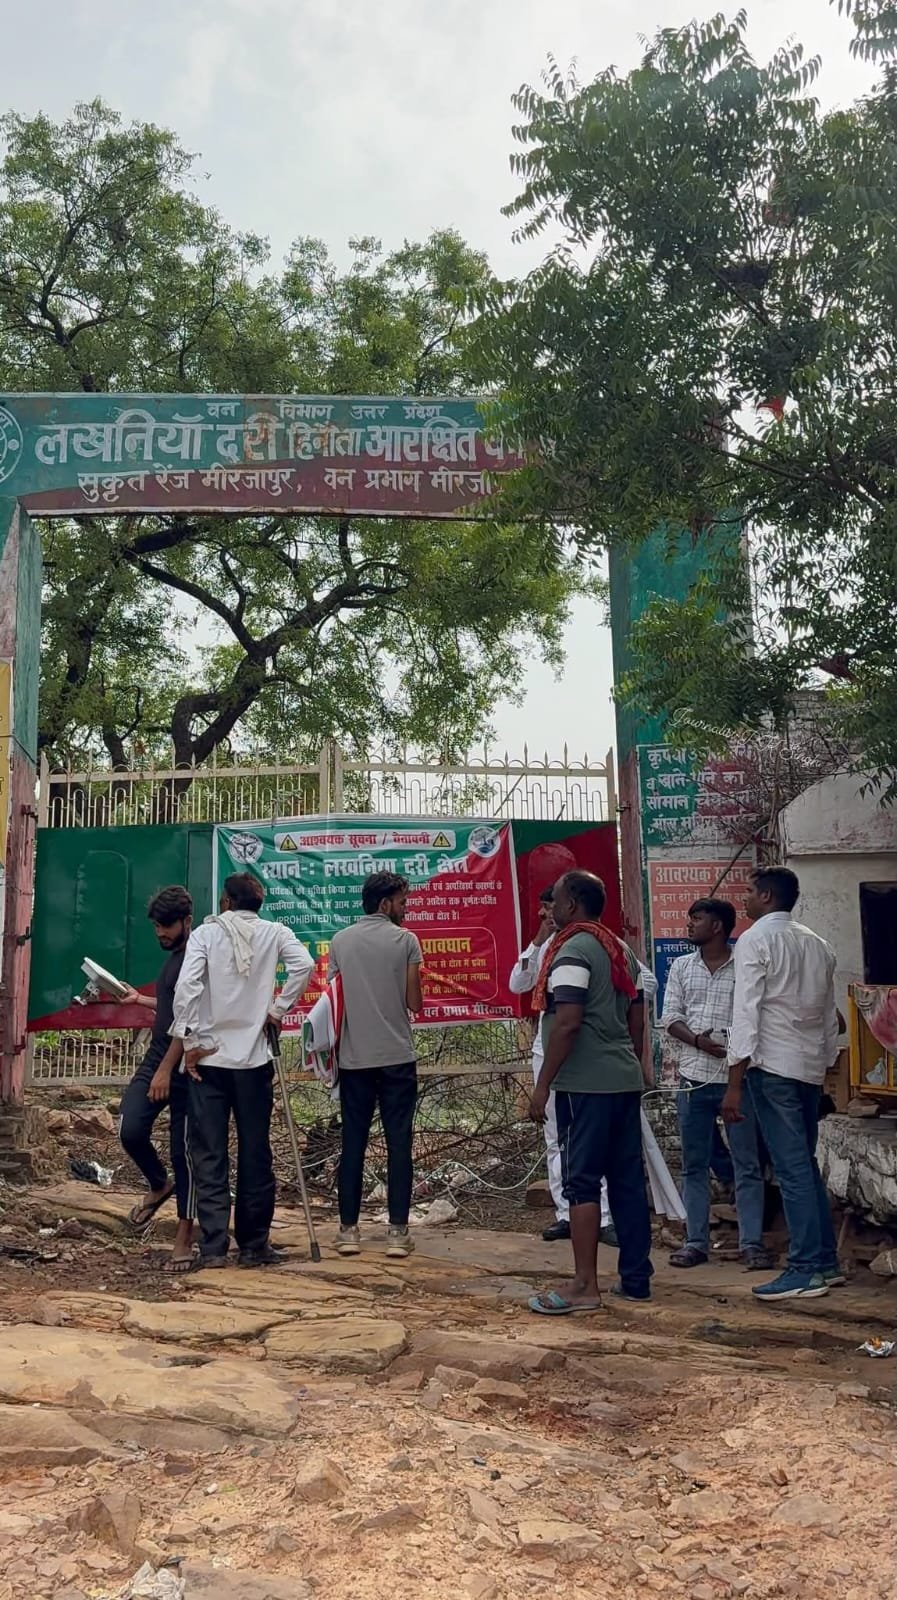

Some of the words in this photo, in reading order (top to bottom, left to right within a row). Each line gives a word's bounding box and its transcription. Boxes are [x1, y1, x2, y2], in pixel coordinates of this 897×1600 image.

[207, 402, 240, 419] वन
[277, 400, 335, 420] विभाग
[77, 471, 150, 503] सुकृत
[153, 463, 195, 492] रेंज
[324, 467, 354, 490] वन
[364, 468, 424, 493] प्रभाग
[348, 834, 377, 848] सूचना
[402, 853, 430, 875] दरी
[421, 937, 471, 954] प्रावधान
[424, 1007, 439, 1017] वन
